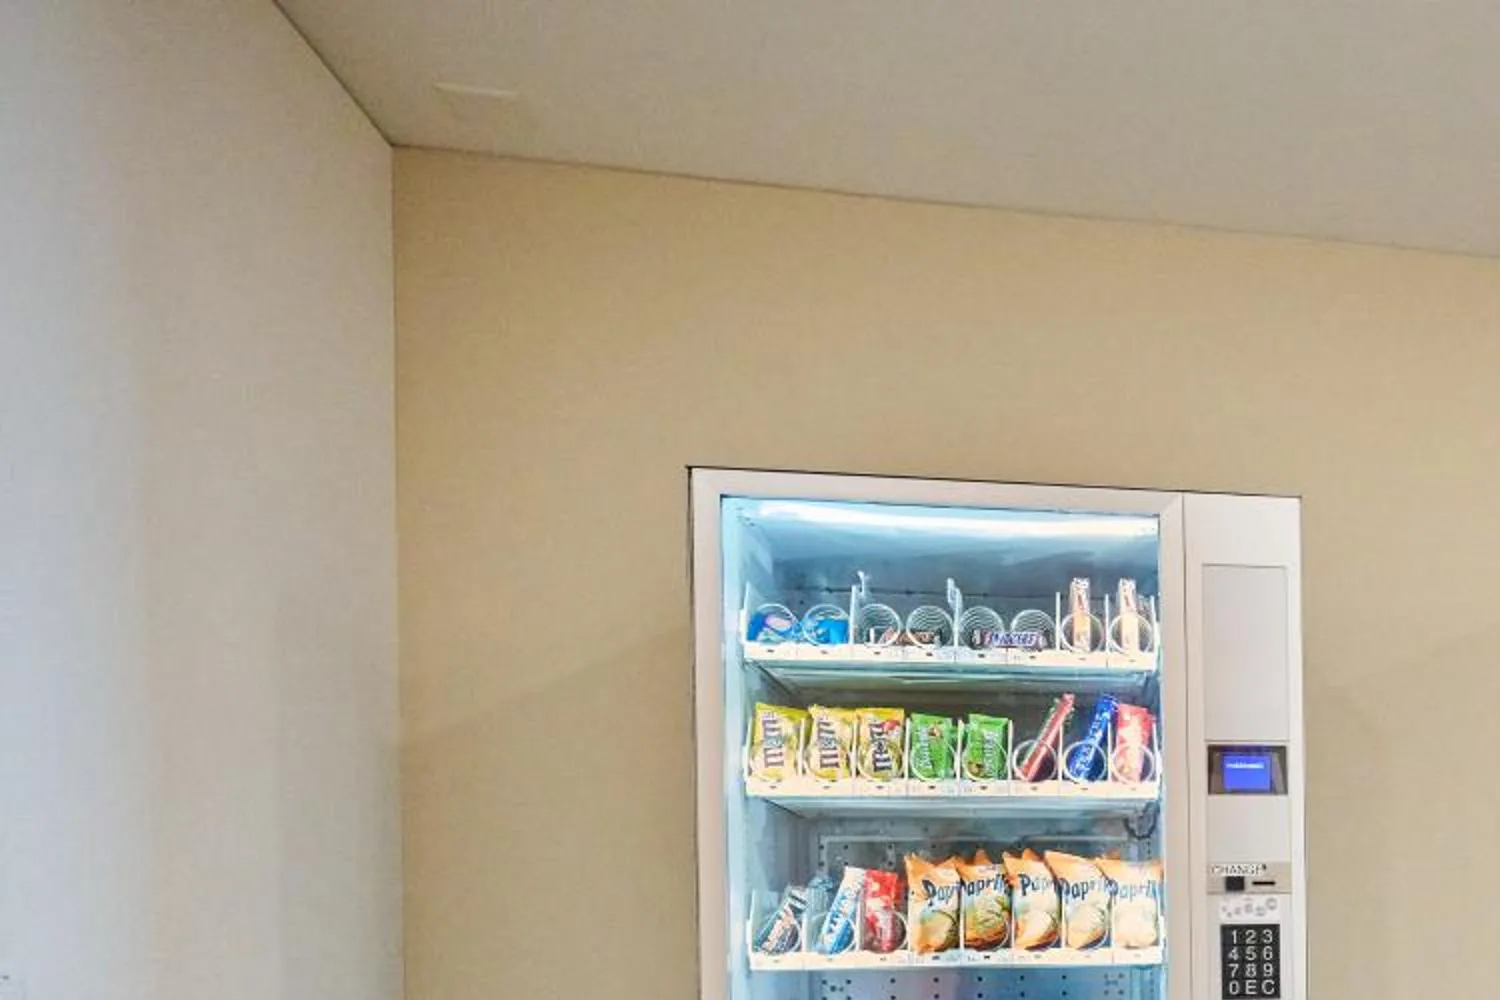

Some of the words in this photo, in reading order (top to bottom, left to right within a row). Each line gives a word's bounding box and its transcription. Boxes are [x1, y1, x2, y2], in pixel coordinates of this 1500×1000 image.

[1231, 929, 1237, 944] 1
[1245, 929, 1257, 944] 2
[1263, 928, 1273, 944] 3
[1228, 946, 1239, 960] 4
[1245, 945, 1257, 960] 5
[1263, 945, 1273, 960] 6
[1228, 963, 1239, 978] 7
[1245, 963, 1257, 977] 8
[1263, 962, 1273, 977] 9
[1229, 980, 1240, 995] 0
[1245, 980, 1257, 995] E
[1261, 979, 1275, 995] C
